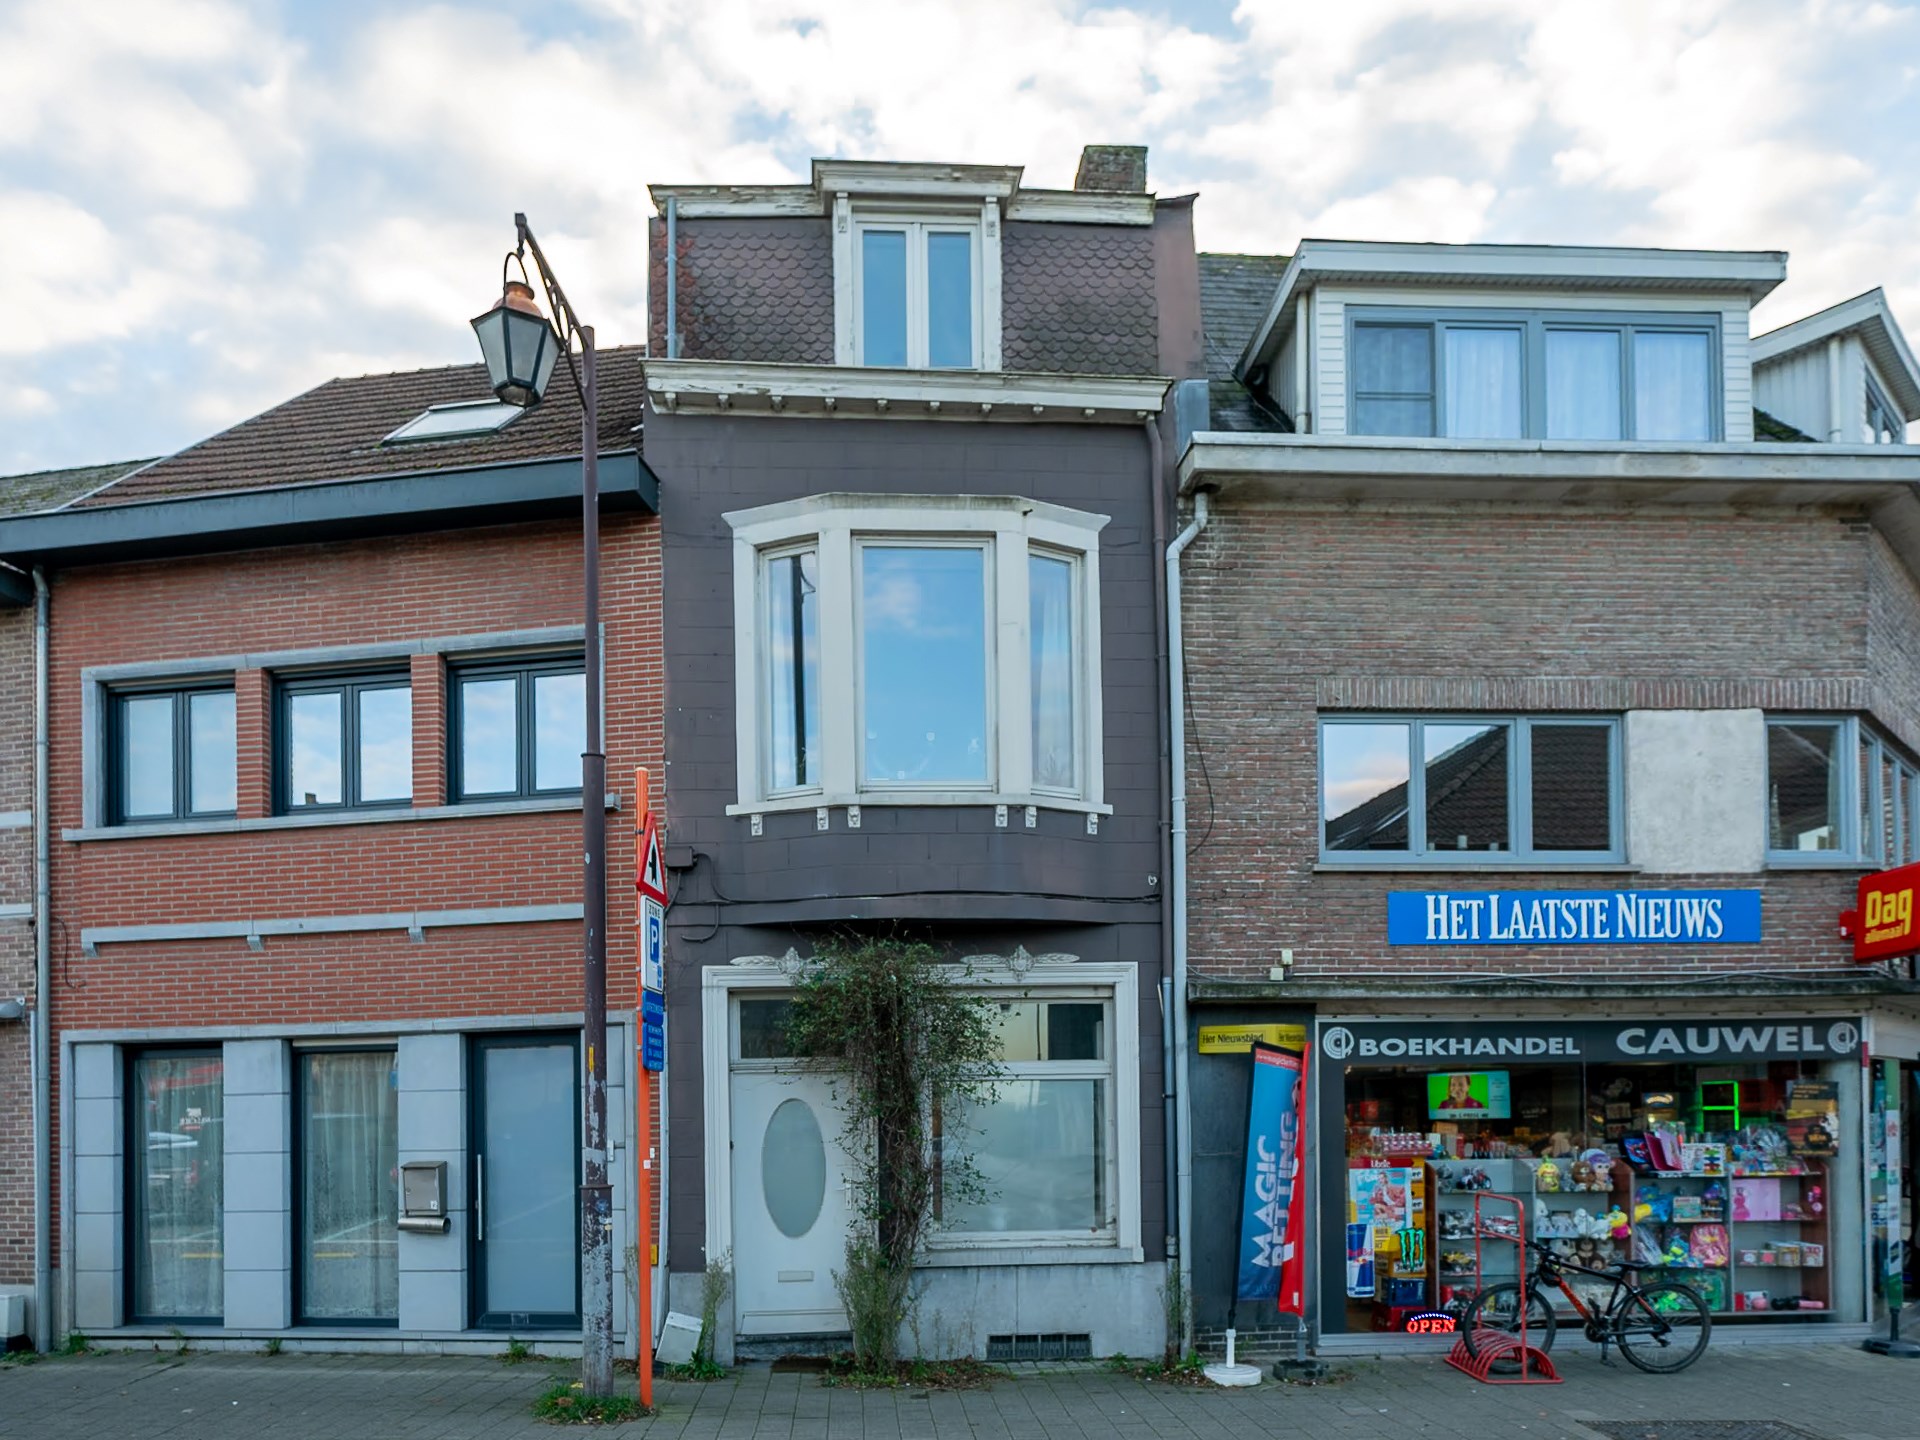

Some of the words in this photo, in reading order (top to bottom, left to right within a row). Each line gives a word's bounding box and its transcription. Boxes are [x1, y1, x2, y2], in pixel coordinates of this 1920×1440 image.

[1426, 894, 1484, 940] HET
[1489, 894, 1610, 940] LAATSTE
[1616, 893, 1725, 940] NIEUWS
[1865, 888, 1913, 935] Dag
[1359, 1037, 1581, 1056] BOEKHANDEL
[1616, 1026, 1825, 1055] CAUWEL
[1251, 1135, 1276, 1267] MAGIC
[1406, 1319, 1457, 1334] OPEN
